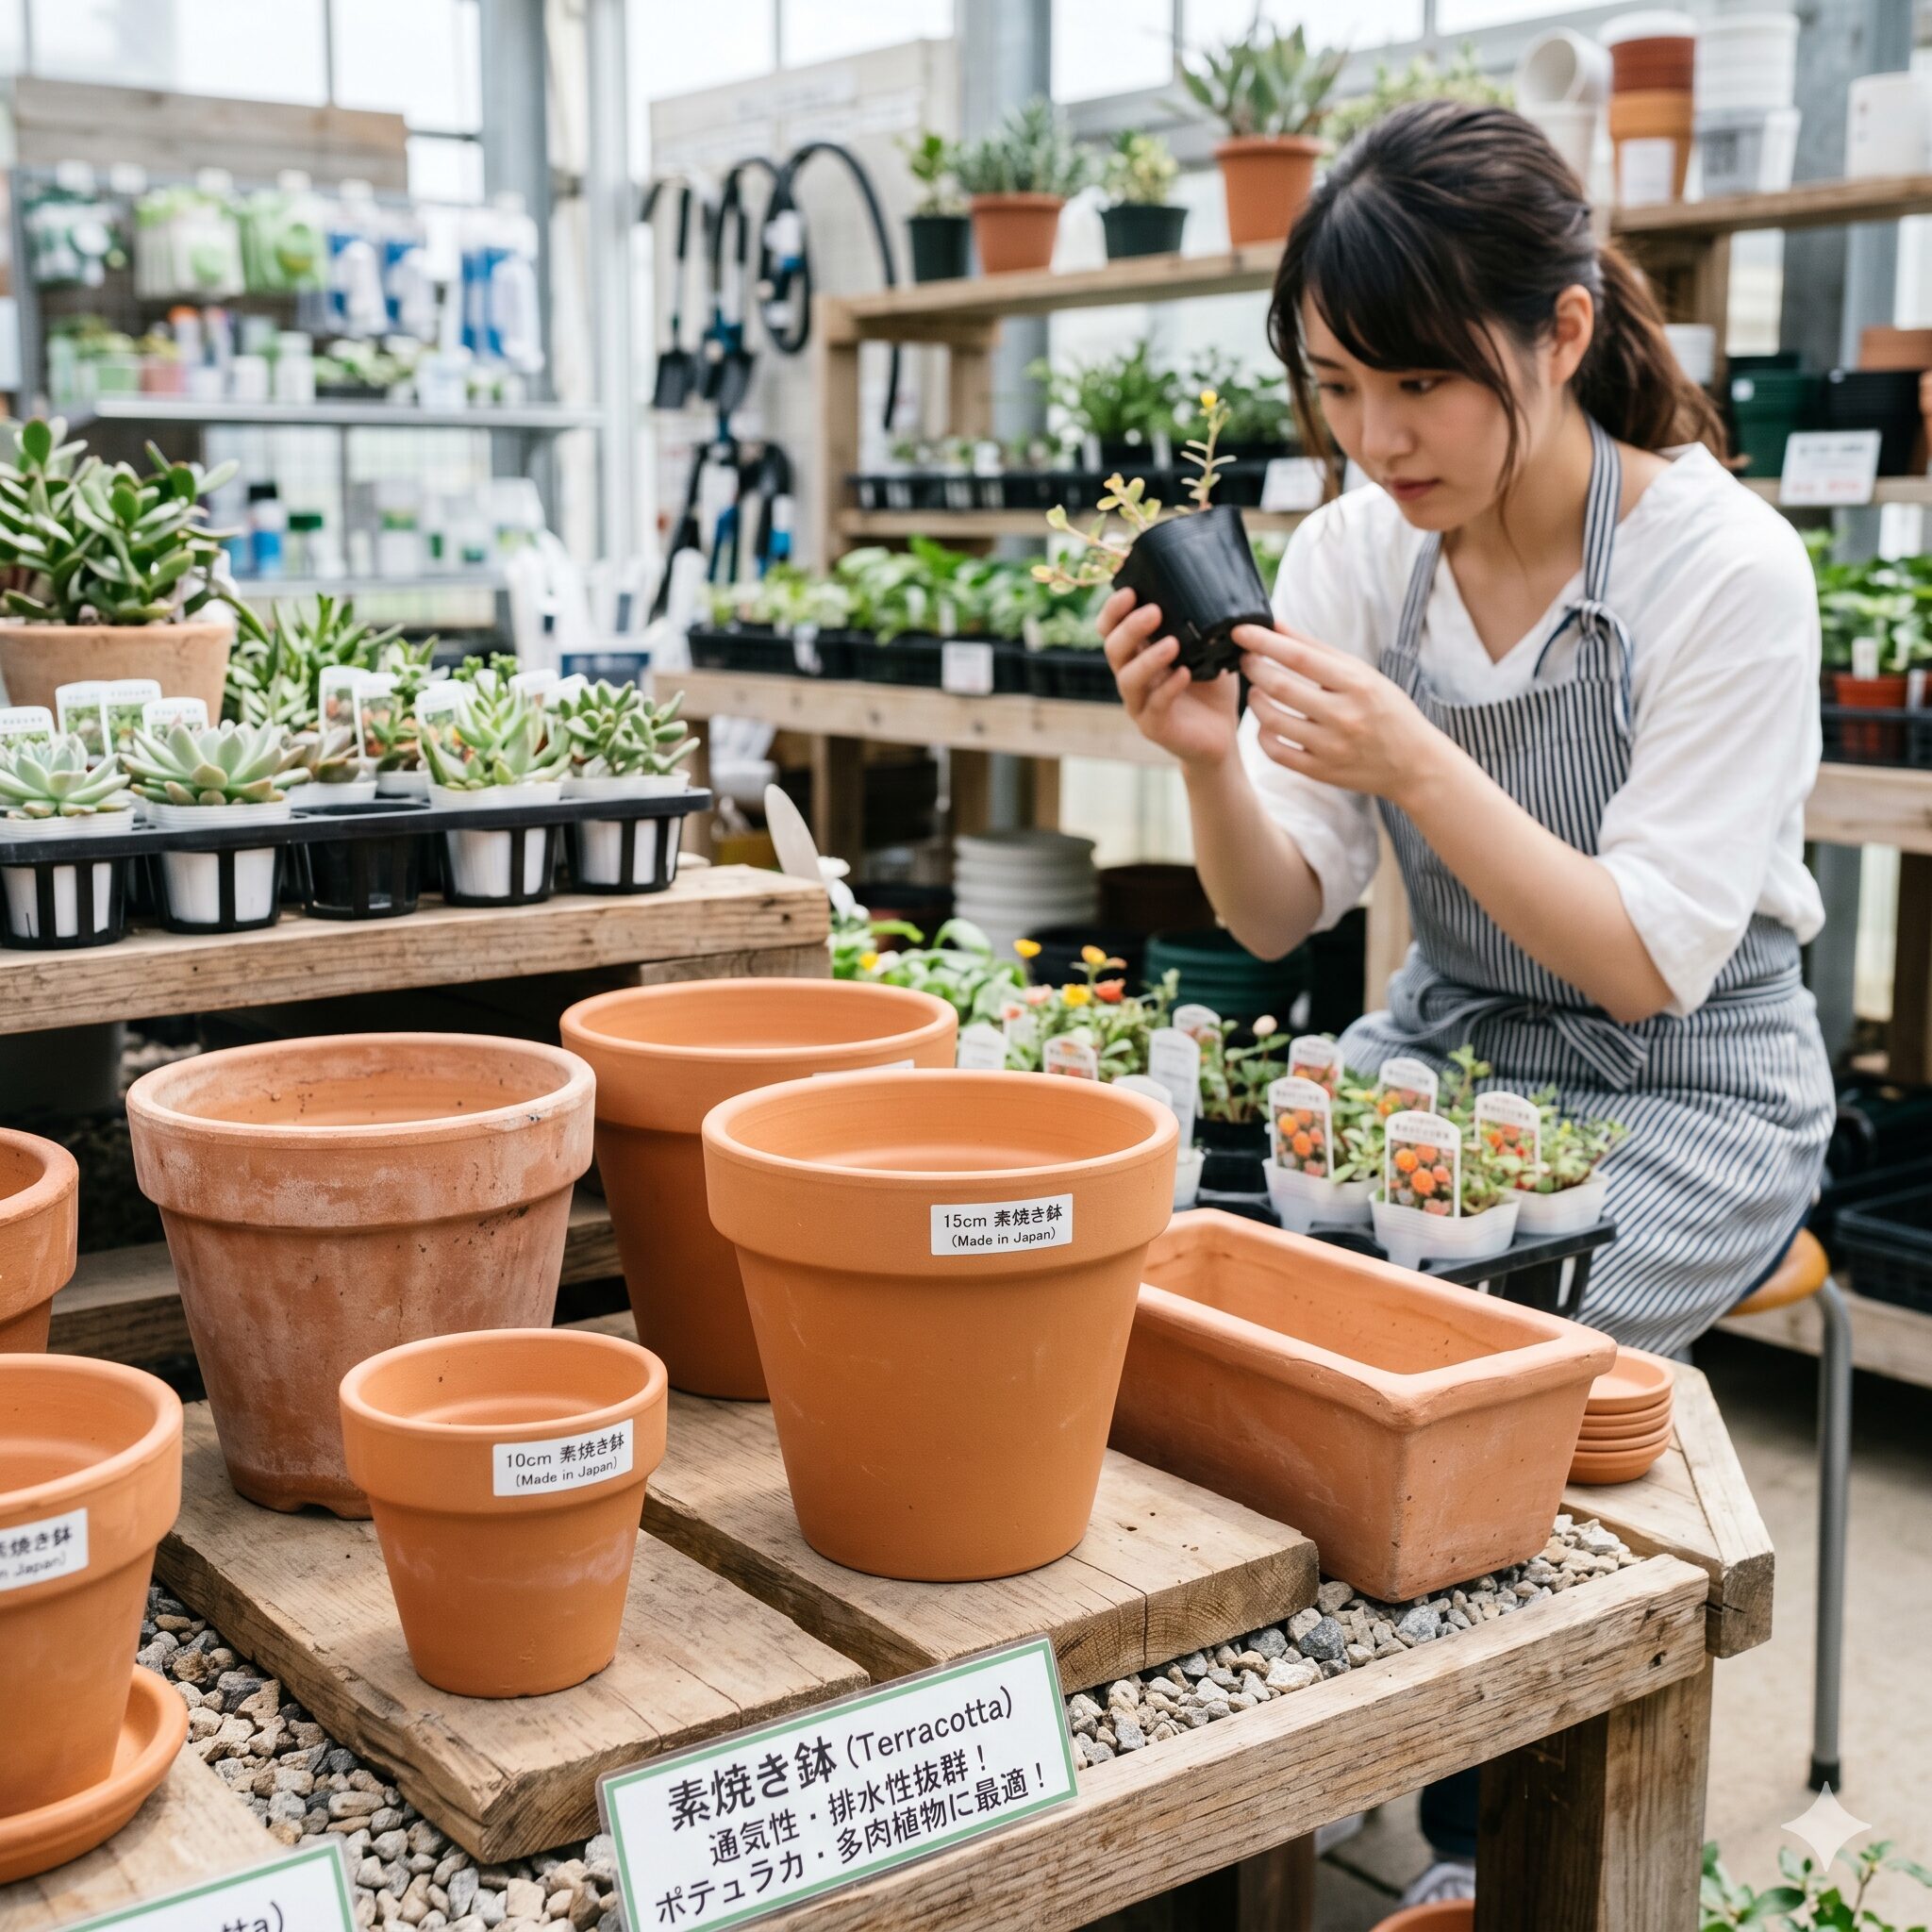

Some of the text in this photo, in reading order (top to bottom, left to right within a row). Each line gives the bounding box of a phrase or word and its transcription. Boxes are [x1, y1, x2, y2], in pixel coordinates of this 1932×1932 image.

[944, 1203, 1063, 1228] 15cm 素焼き鉢
[951, 1226, 1056, 1248] (Made in Japan)
[507, 1432, 625, 1468] 10cm 素焼き鉢
[516, 1456, 618, 1488] (Made in Japan)
[15, 1550, 67, 1576] Japan)
[668, 1685, 1012, 1832] 素焼き鉢 (Terracotta)
[708, 1744, 986, 1866] 通気性・排水性抜群！
[656, 1762, 1044, 1924] ポテュラカ・多肉植物に最適！
